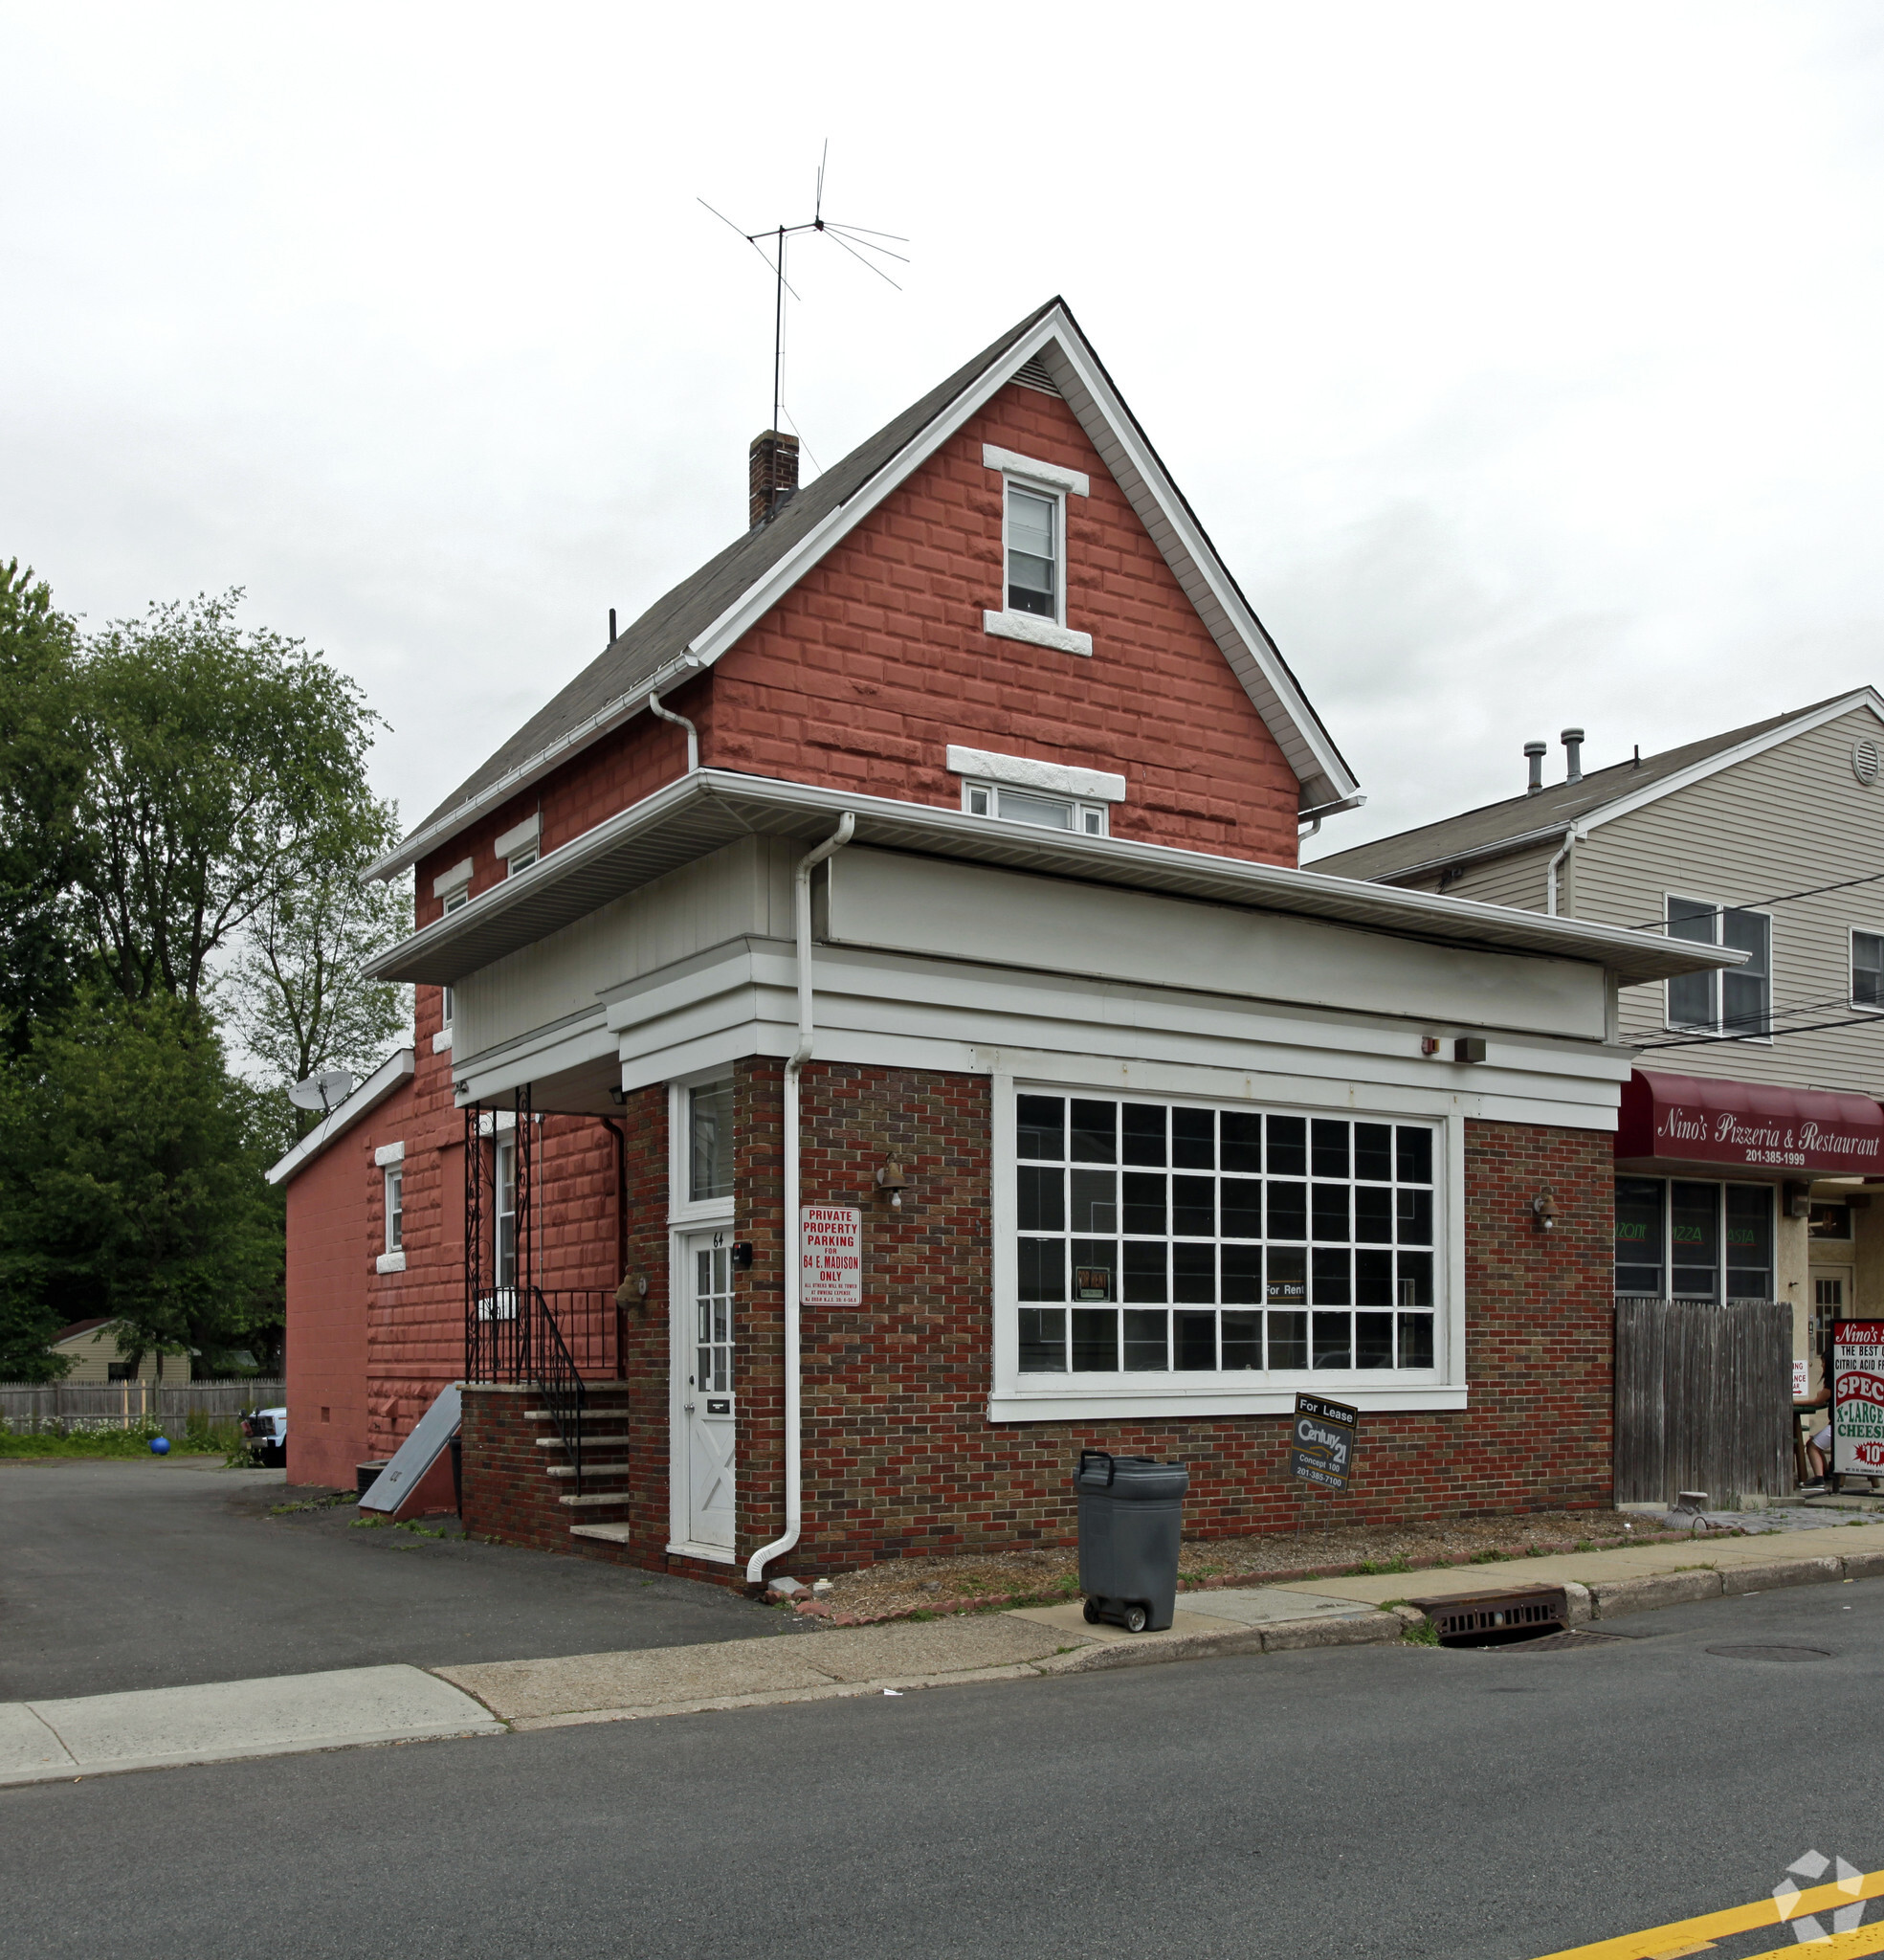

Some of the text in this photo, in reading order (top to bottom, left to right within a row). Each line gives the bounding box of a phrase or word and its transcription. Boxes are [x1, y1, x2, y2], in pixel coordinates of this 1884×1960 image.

[1657, 1108, 1879, 1156] Nino's Pizzeria & Restaurant
[1745, 1148, 1806, 1166] 201-385-1999
[809, 1210, 853, 1221] PRIVATE
[804, 1222, 857, 1234] PROPERTY
[713, 1232, 724, 1248] 64
[809, 1236, 853, 1246] PARKING
[803, 1255, 858, 1269] 64 E. MADISON
[820, 1270, 842, 1281] ONLY
[1284, 1285, 1304, 1294] Rent
[1835, 1324, 1878, 1343] Nino's
[1841, 1345, 1856, 1356] THE
[1859, 1345, 1878, 1356] BEST
[1835, 1359, 1857, 1370] CITRIC
[1859, 1359, 1875, 1370] ACID
[1300, 1399, 1353, 1422] For Lease
[1836, 1402, 1884, 1424] X-LARGE
[1297, 1419, 1346, 1463] Century 21
[1299, 1454, 1341, 1473] Concept 100
